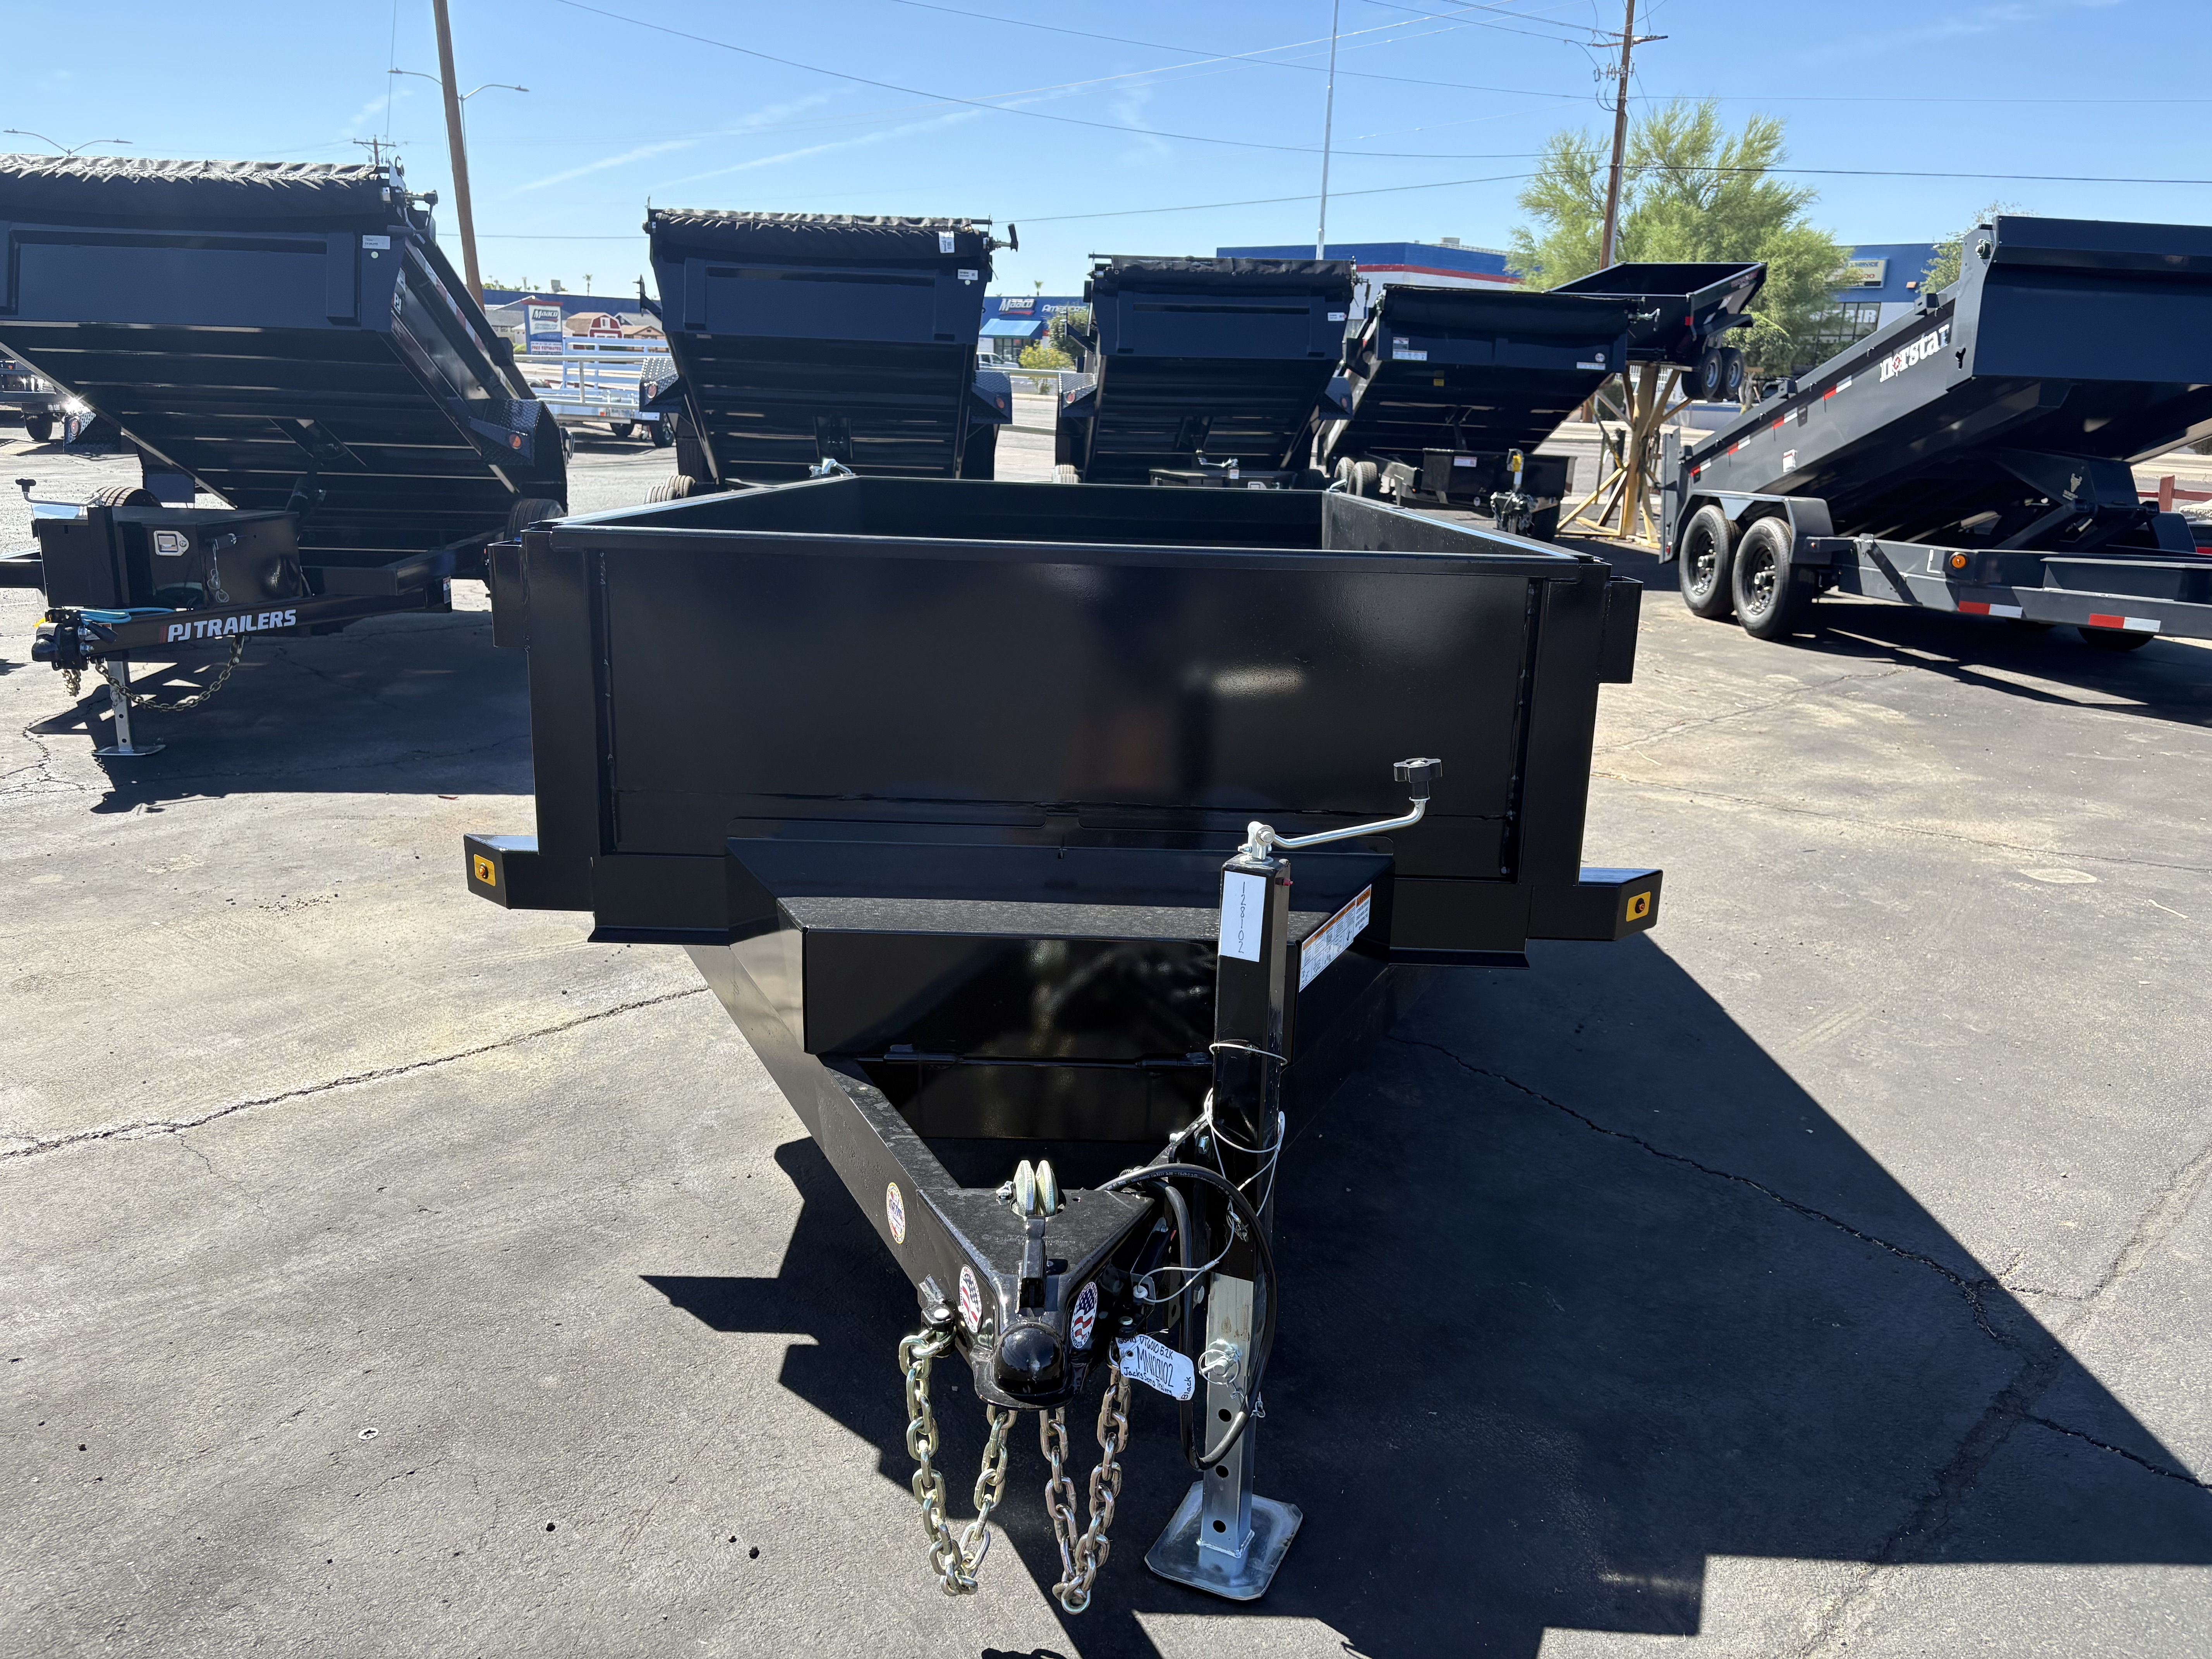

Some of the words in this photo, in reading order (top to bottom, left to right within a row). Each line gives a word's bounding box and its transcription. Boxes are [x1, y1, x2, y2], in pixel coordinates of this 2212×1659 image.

[532, 309, 558, 319] Maaco
[998, 299, 1034, 311] Maaco
[167, 622, 191, 642] PJ
[194, 609, 296, 638] TRAILERS
[1238, 881, 1247, 954] 128102
[1181, 1376, 1191, 1400] Black
